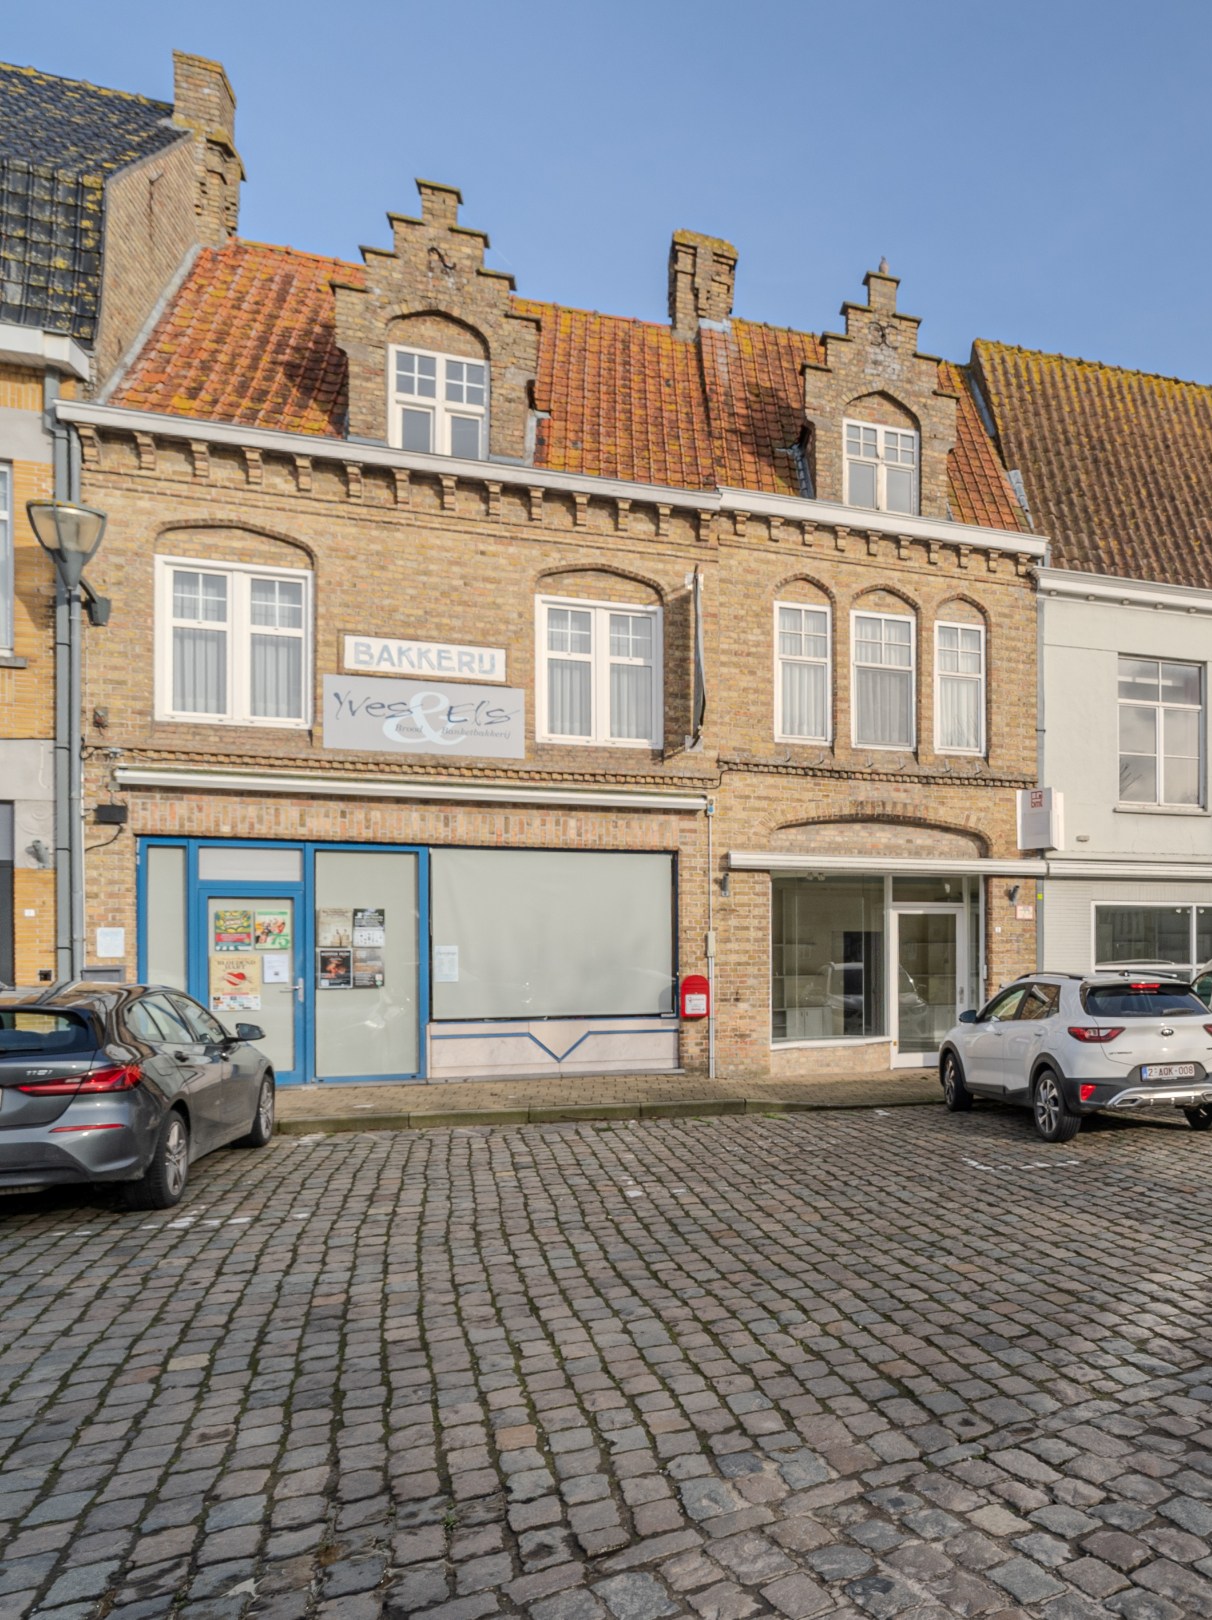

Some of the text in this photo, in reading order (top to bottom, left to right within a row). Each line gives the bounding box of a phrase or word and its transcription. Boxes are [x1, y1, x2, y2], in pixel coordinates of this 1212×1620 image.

[353, 641, 496, 675] BAKKERIJ
[333, 691, 521, 746] Yves & Els
[394, 723, 512, 740] Brood Banketbakkerij
